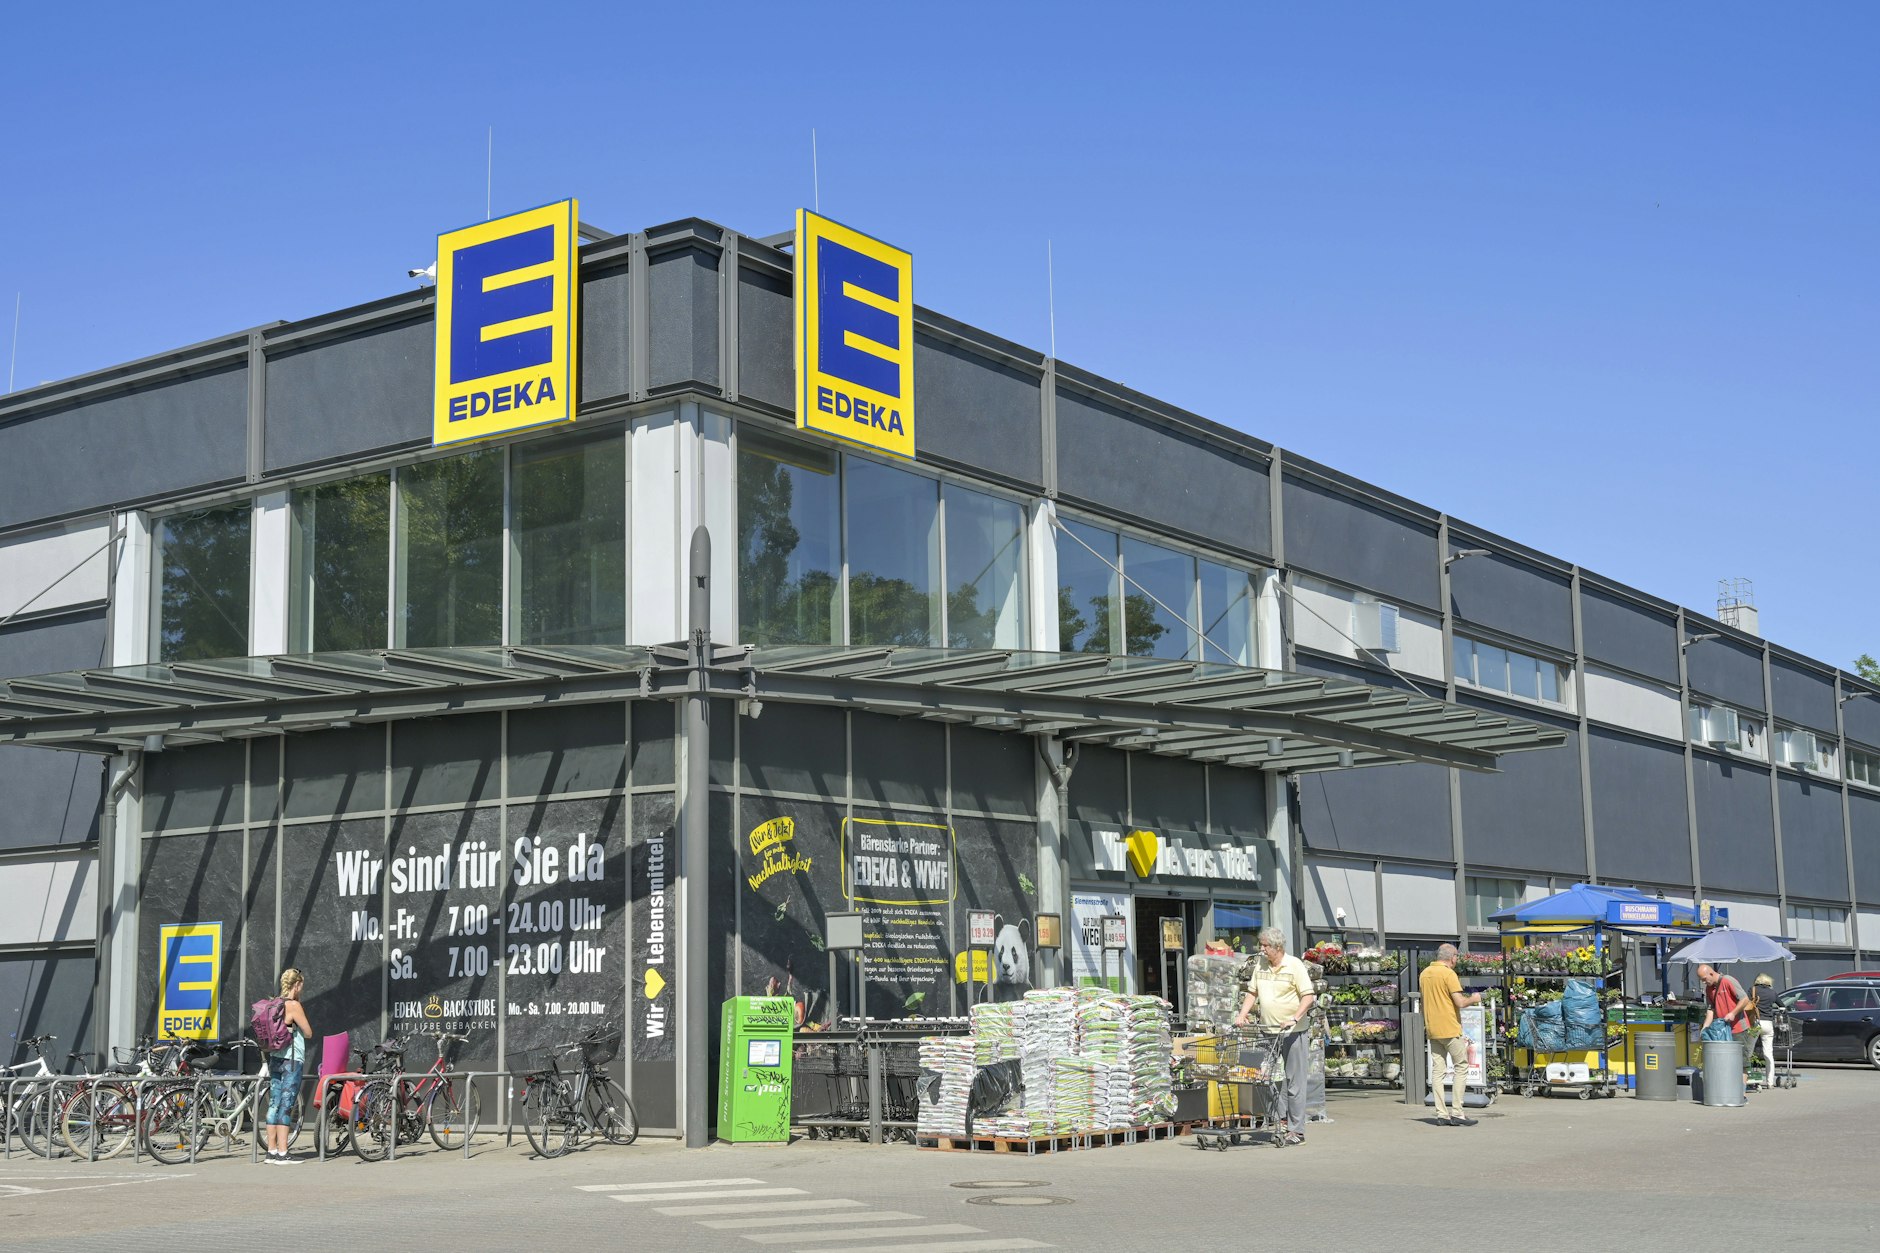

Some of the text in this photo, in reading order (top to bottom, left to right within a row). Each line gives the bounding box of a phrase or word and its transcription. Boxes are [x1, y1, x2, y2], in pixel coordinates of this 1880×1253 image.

[450, 224, 554, 385] E
[817, 235, 900, 398] E
[449, 376, 556, 423] EDEKA
[817, 385, 905, 437] EDEKA
[751, 830, 766, 849] Wir
[772, 821, 792, 838] Jetzt
[861, 834, 941, 856] Bärenstarke Partner:
[336, 833, 604, 896] Wir sind für Sie da
[748, 852, 812, 892] Nachhaltigkeit
[854, 855, 948, 890] EDEKA & WWF
[449, 904, 488, 936] 7.00
[507, 900, 563, 934] 24.00
[569, 898, 606, 931] Uhr
[904, 908, 917, 916] EDEKA
[1623, 912, 1657, 920] WINKELMANN
[1625, 905, 1657, 913] BUSCHMANN
[646, 831, 665, 1039] Wir Lebensmittel.
[1082, 928, 1101, 946] WEG
[164, 934, 214, 1011] E
[390, 948, 418, 980] Sa.
[448, 945, 488, 977] 7.00
[507, 942, 562, 975] 23.00
[569, 940, 606, 974] Uhr
[394, 999, 496, 1018] EDEKA BACKSTUBE
[508, 1002, 523, 1015] Mo.
[529, 1003, 540, 1015] Sa.
[544, 1002, 562, 1015] 7.00
[567, 1002, 590, 1015] 20.00
[591, 1001, 605, 1015] Uhr
[164, 1016, 212, 1032] EDEKA
[393, 1021, 497, 1032] MIT LIEBE GEBACKEN
[758, 1080, 782, 1096] pin
